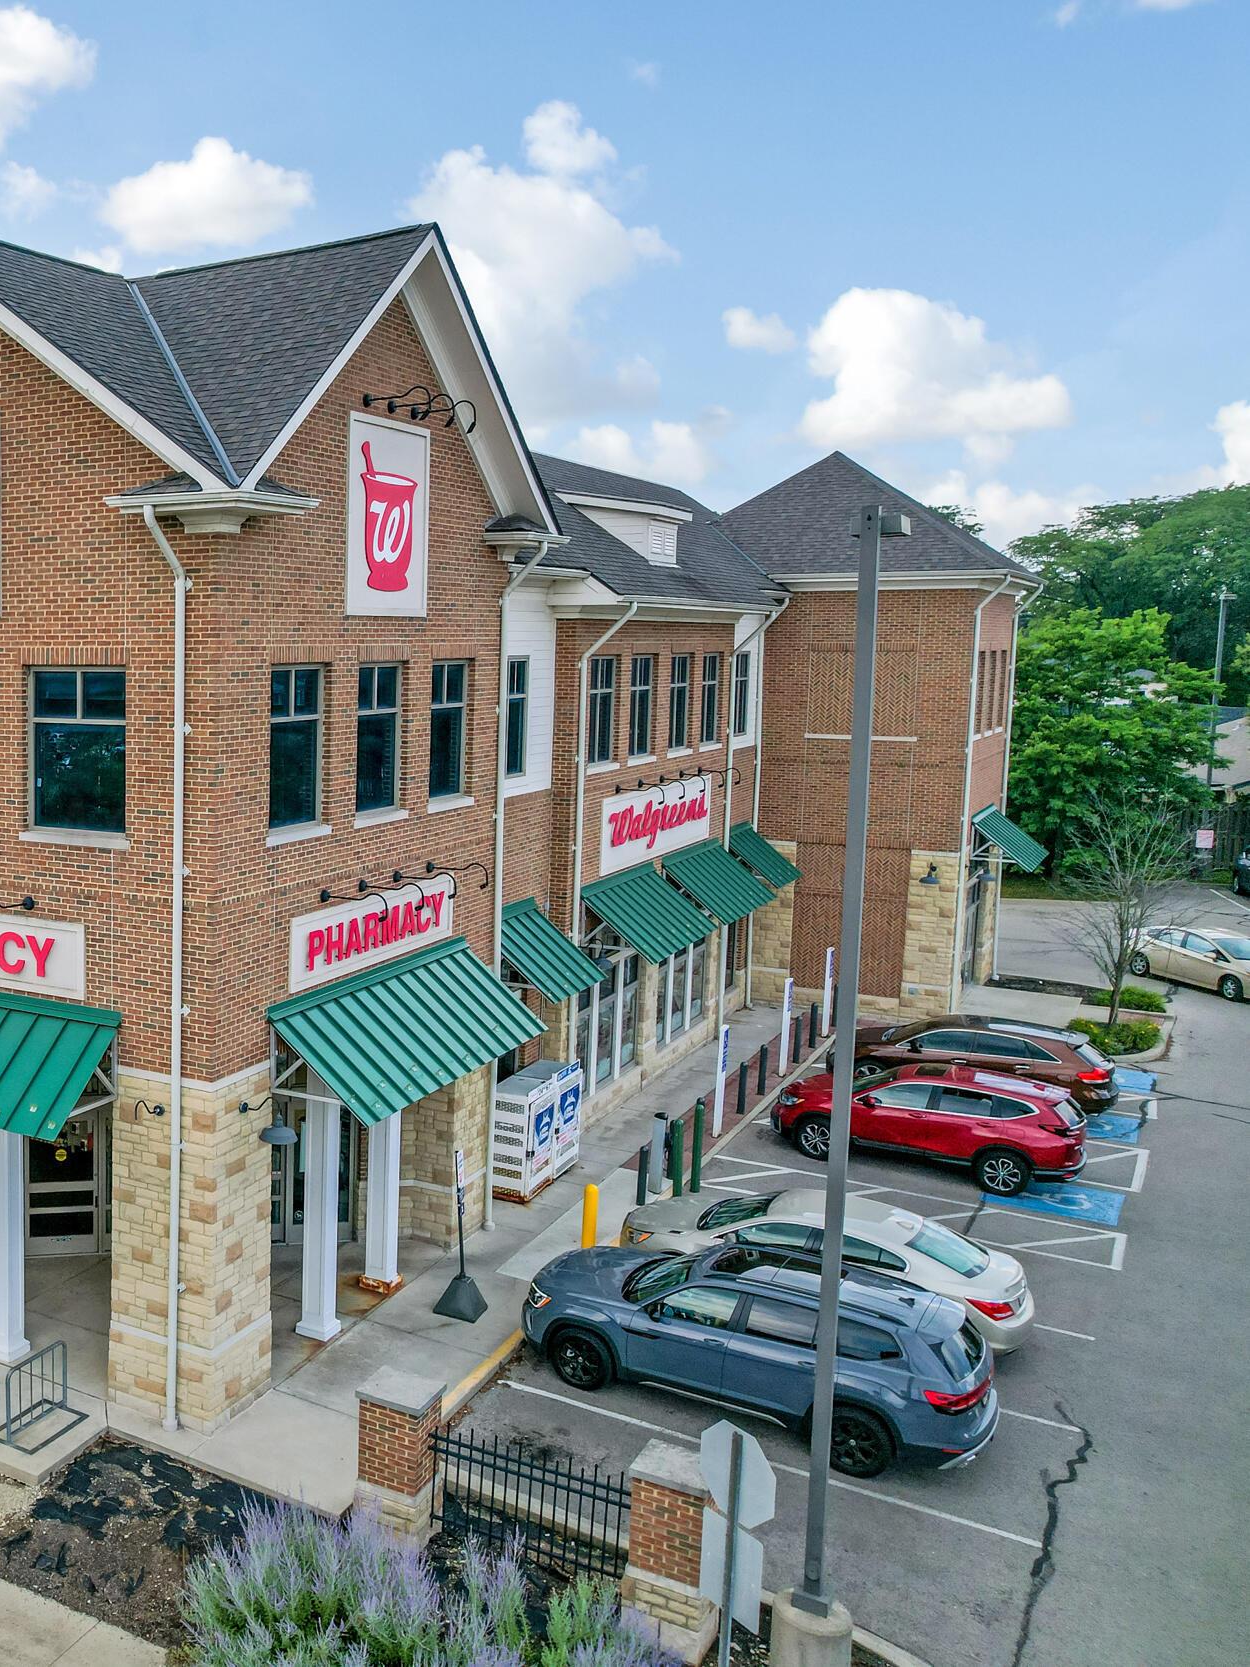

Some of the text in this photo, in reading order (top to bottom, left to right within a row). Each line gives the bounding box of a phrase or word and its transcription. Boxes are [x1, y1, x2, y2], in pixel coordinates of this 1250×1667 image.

[369, 499, 411, 564] W
[608, 793, 708, 849] Walgreens
[307, 890, 446, 972] PHARMACY
